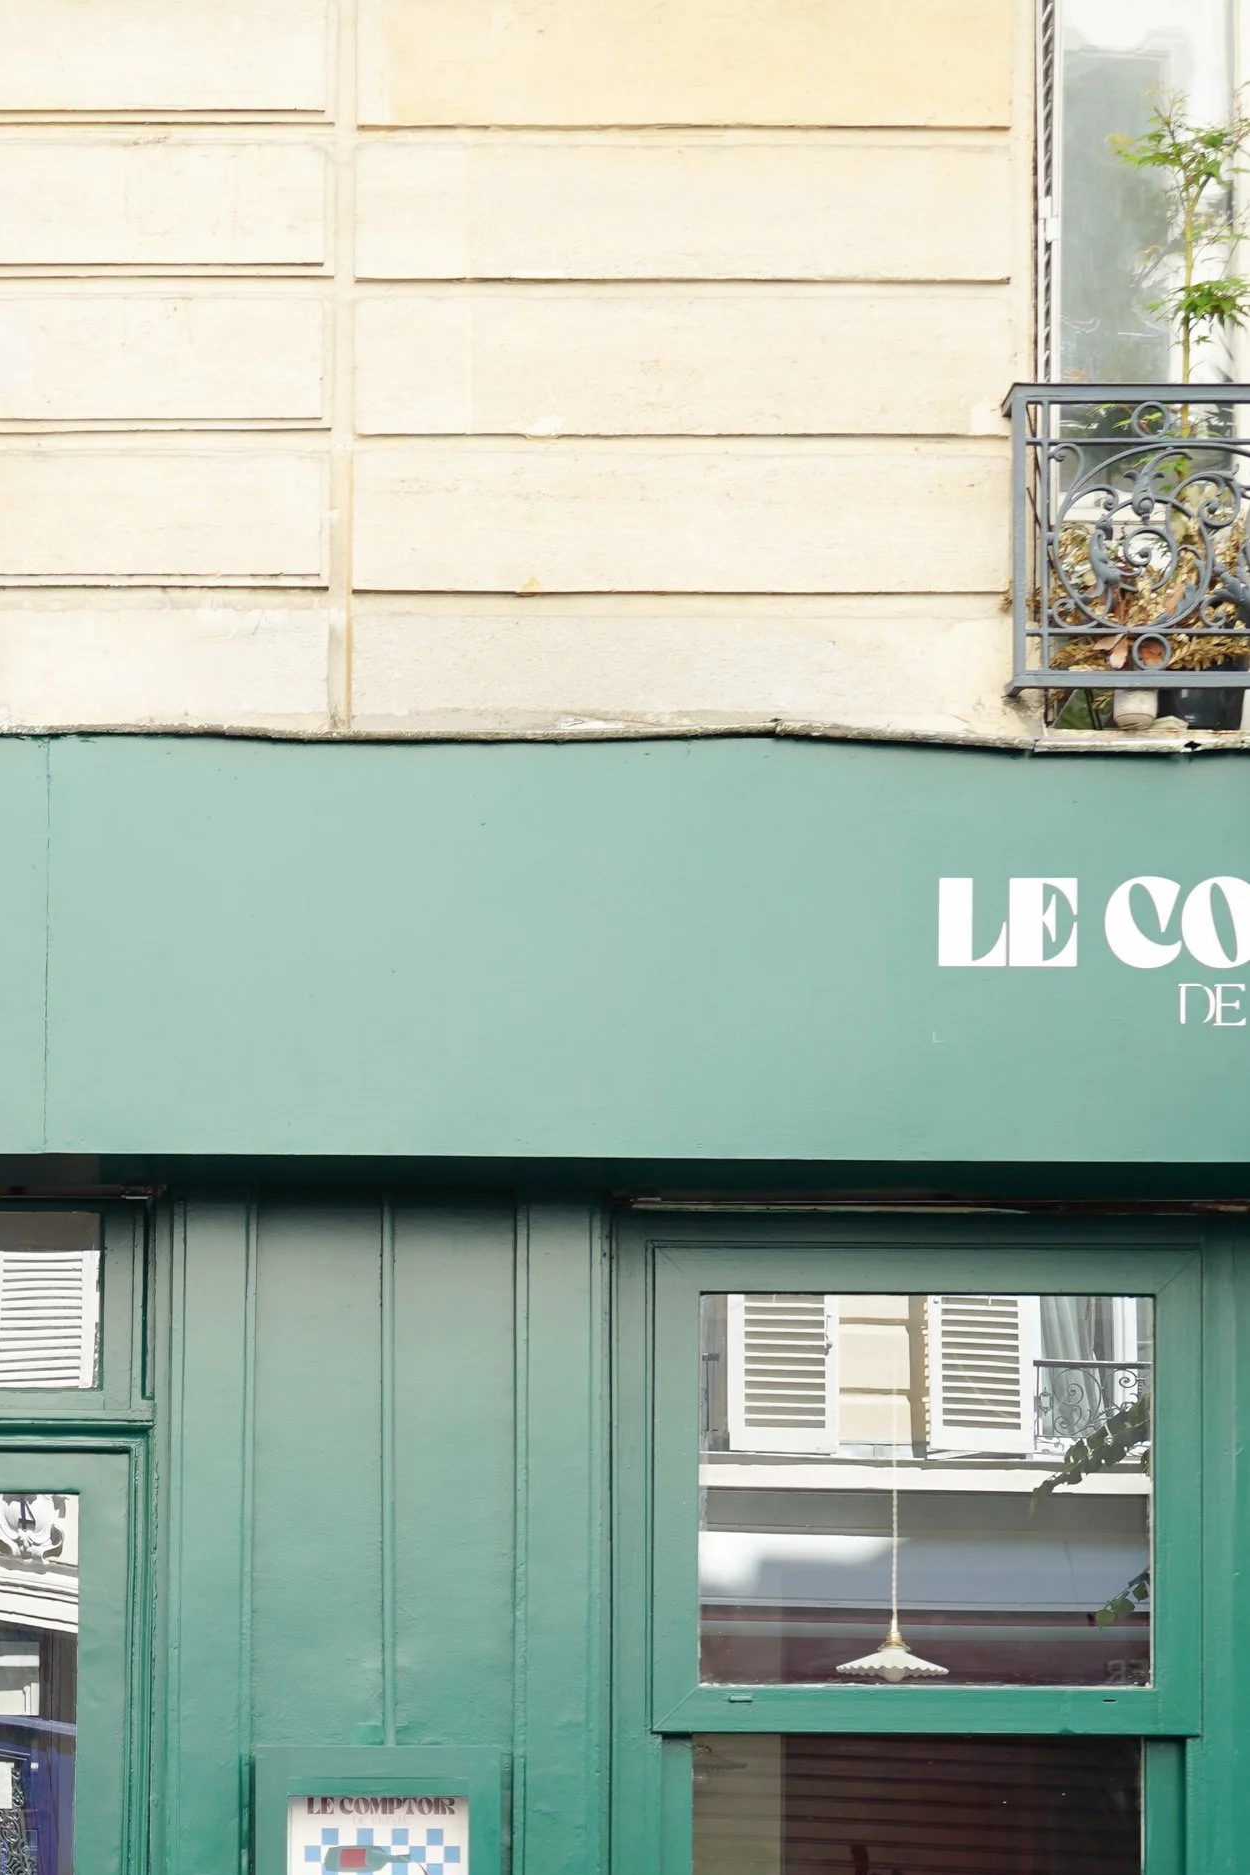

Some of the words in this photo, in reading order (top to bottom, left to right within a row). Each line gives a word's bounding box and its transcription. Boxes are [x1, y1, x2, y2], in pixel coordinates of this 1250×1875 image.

[938, 877, 1078, 967] LE
[1104, 875, 1250, 969] CO
[1177, 983, 1247, 1027] DE
[306, 1797, 335, 1815] LE
[339, 1796, 456, 1816] COMPTOIR
